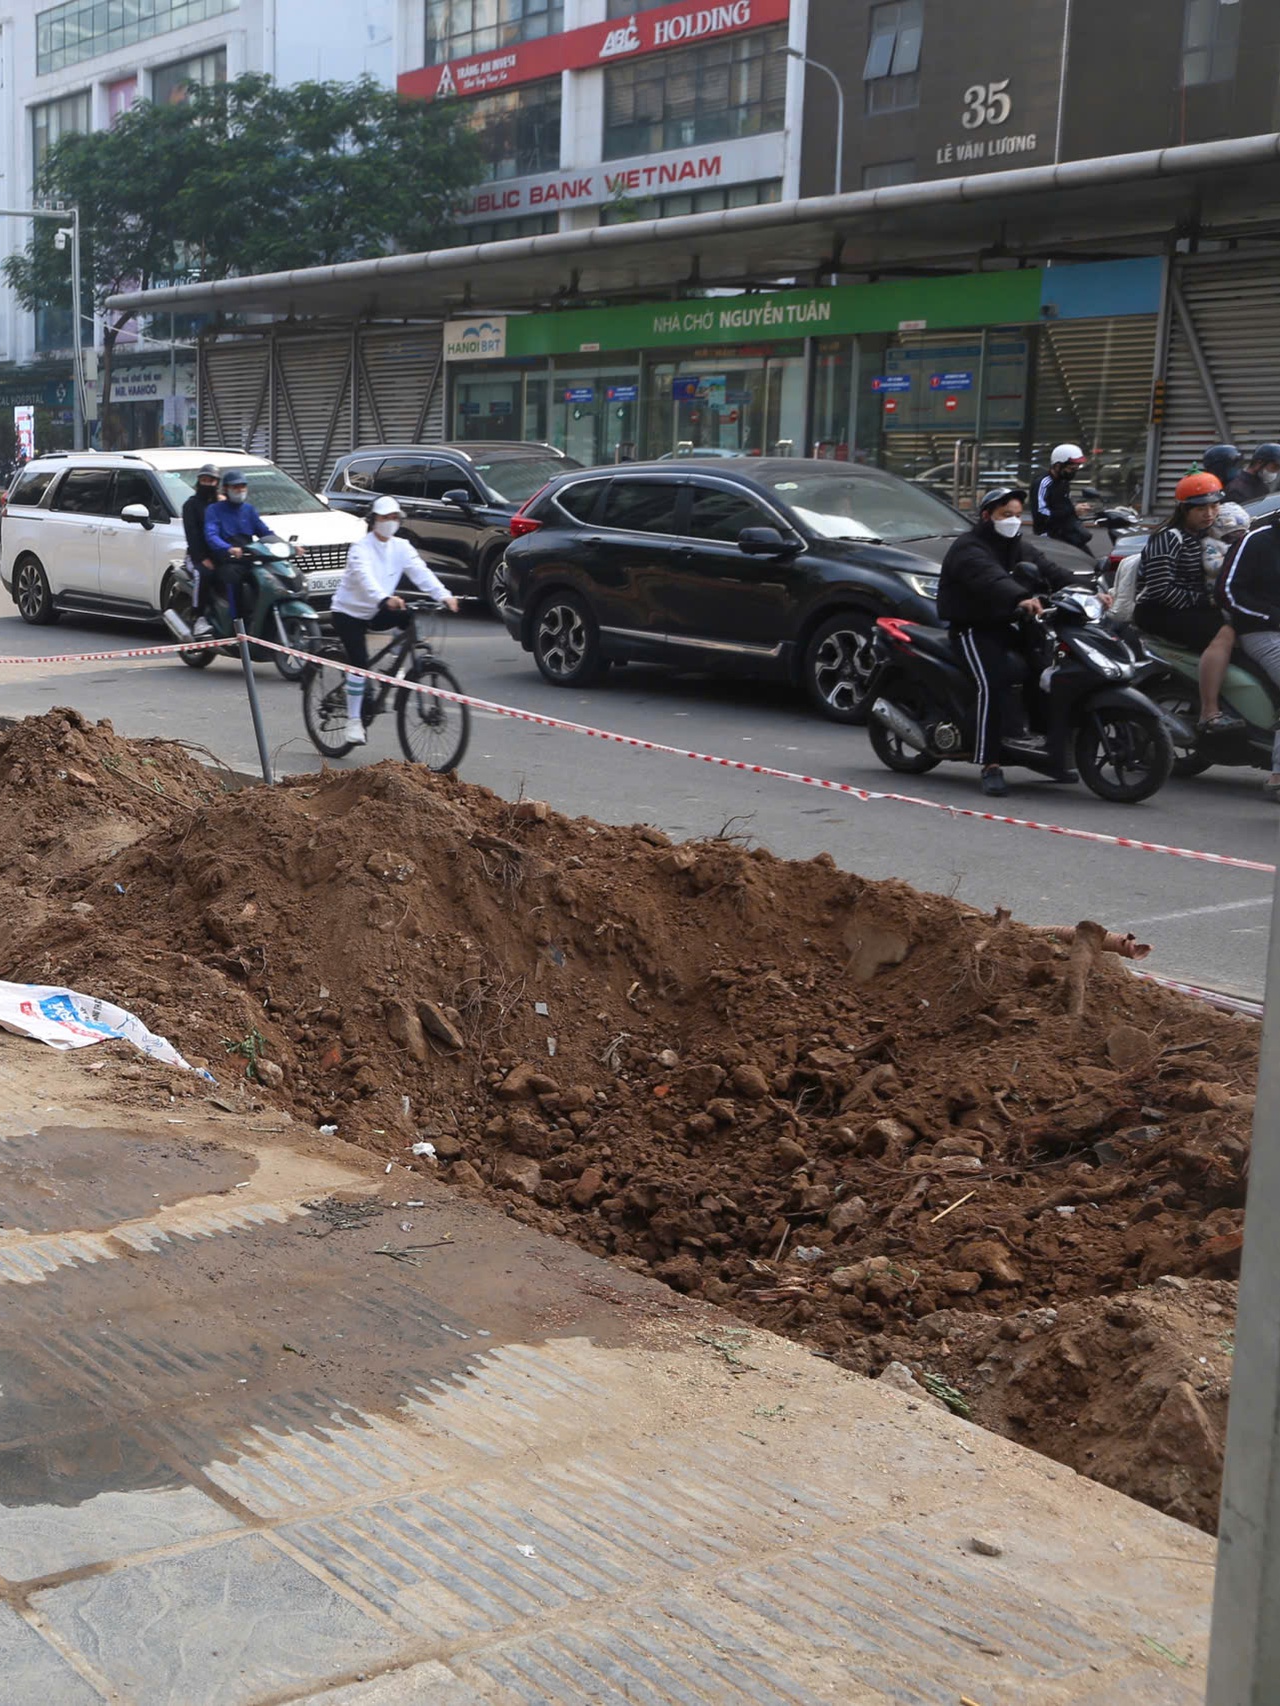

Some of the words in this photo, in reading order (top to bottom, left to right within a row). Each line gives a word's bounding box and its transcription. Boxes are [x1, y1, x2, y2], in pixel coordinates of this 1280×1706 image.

[600, 26, 640, 57] ABC
[654, 1, 751, 45] HOLDING
[962, 78, 1011, 129] 35
[936, 143, 953, 164] LÊ
[956, 140, 984, 161] VĂN
[988, 134, 1037, 156] LƯƠNG
[529, 177, 593, 205] BANK
[604, 155, 722, 193] VIETNAM
[653, 313, 681, 333] NHÀ
[683, 309, 714, 331] CHỜ
[719, 301, 784, 329] NGUYỄN
[447, 342, 480, 354] HANOI
[481, 339, 501, 352] BRT
[11, 394, 44, 405] HOSPITAL
